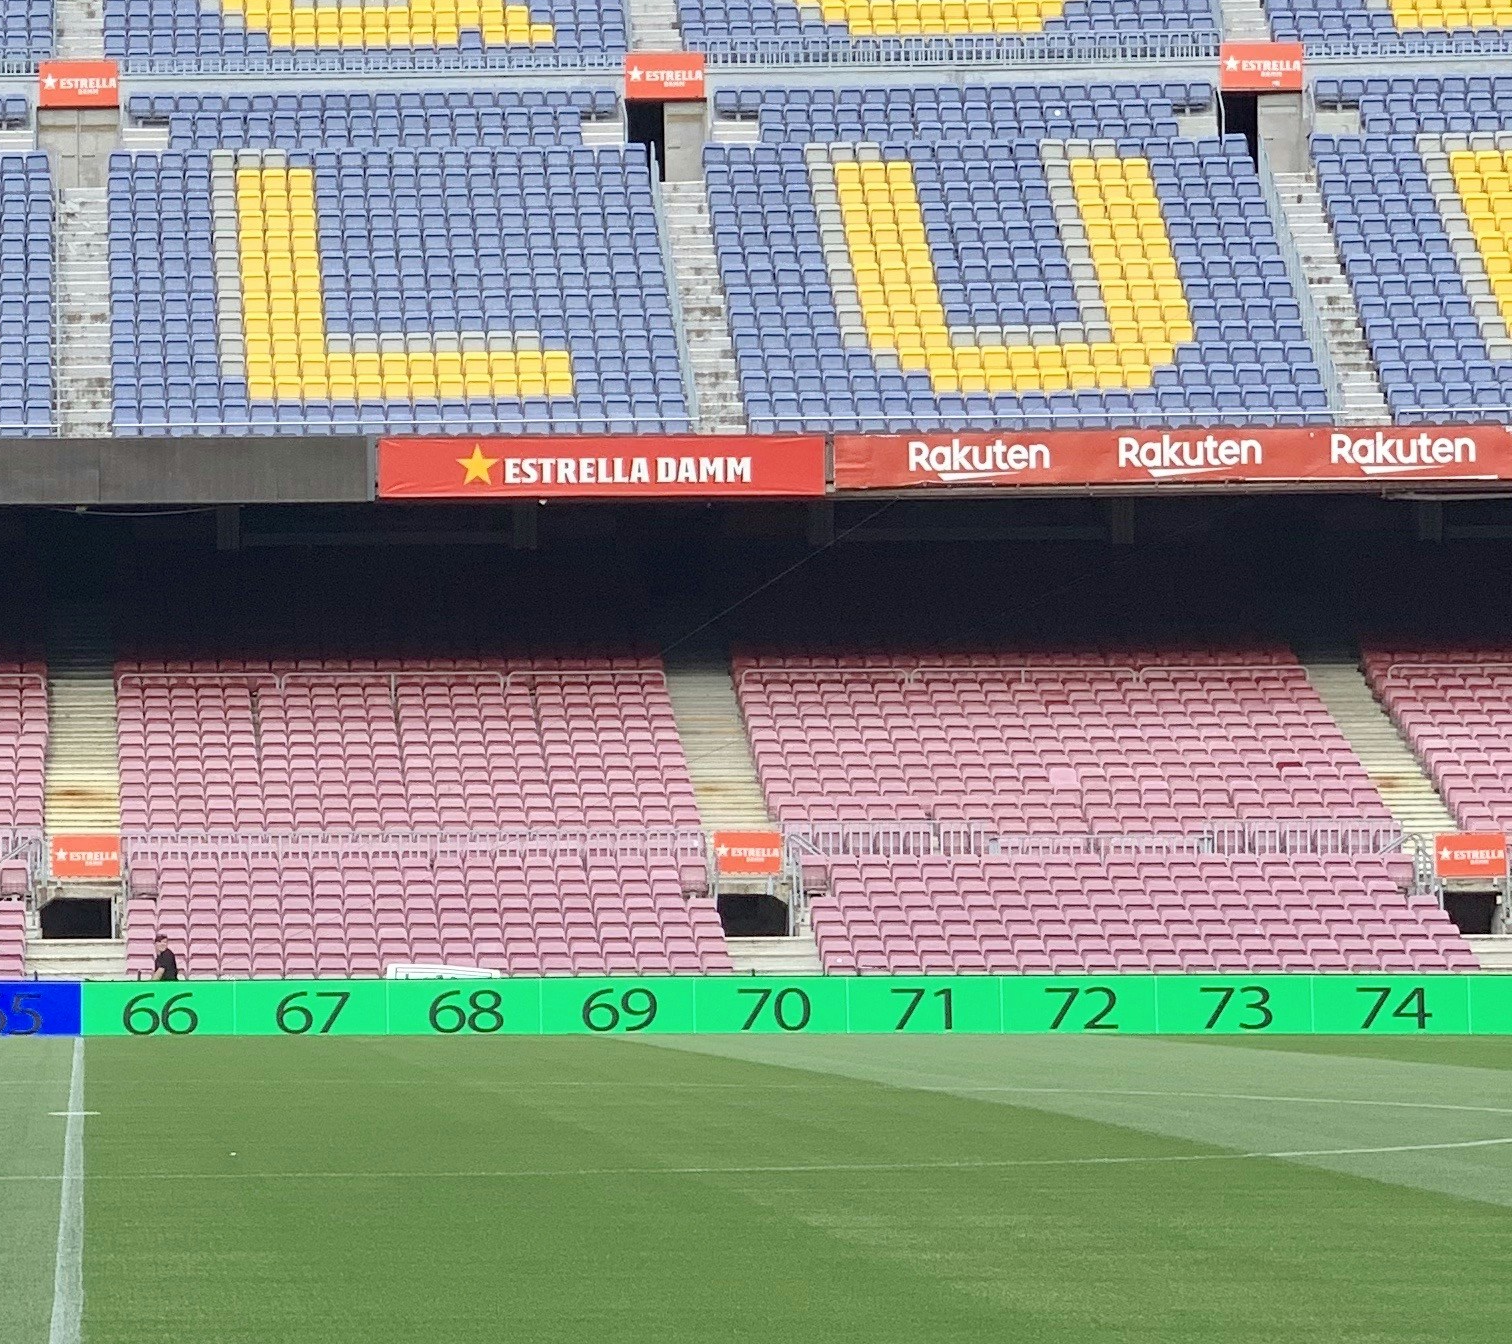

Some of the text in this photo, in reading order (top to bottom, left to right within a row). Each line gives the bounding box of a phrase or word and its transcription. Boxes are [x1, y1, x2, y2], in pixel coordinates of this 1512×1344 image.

[645, 70, 704, 81] ESTRELLA
[1241, 60, 1302, 72] ESTRELLA
[59, 77, 117, 89] ESTRELLA
[908, 439, 1051, 472] Rakuten
[1118, 434, 1263, 467] Rakuten
[1330, 431, 1476, 464] Rakuten
[504, 457, 753, 484] ESTRELLA DAMM
[69, 851, 118, 861] ESTRELLA
[730, 847, 780, 857] ESTRELLA
[1453, 849, 1505, 860] ESTRELLA
[123, 992, 198, 1035] 66
[276, 991, 351, 1034] 67
[429, 989, 504, 1033] 68
[582, 988, 658, 1033] 69
[738, 987, 811, 1032] 70
[890, 987, 953, 1031] 71
[1044, 986, 1119, 1030] 72
[1199, 986, 1274, 1030] 73
[1356, 987, 1433, 1030] 74
